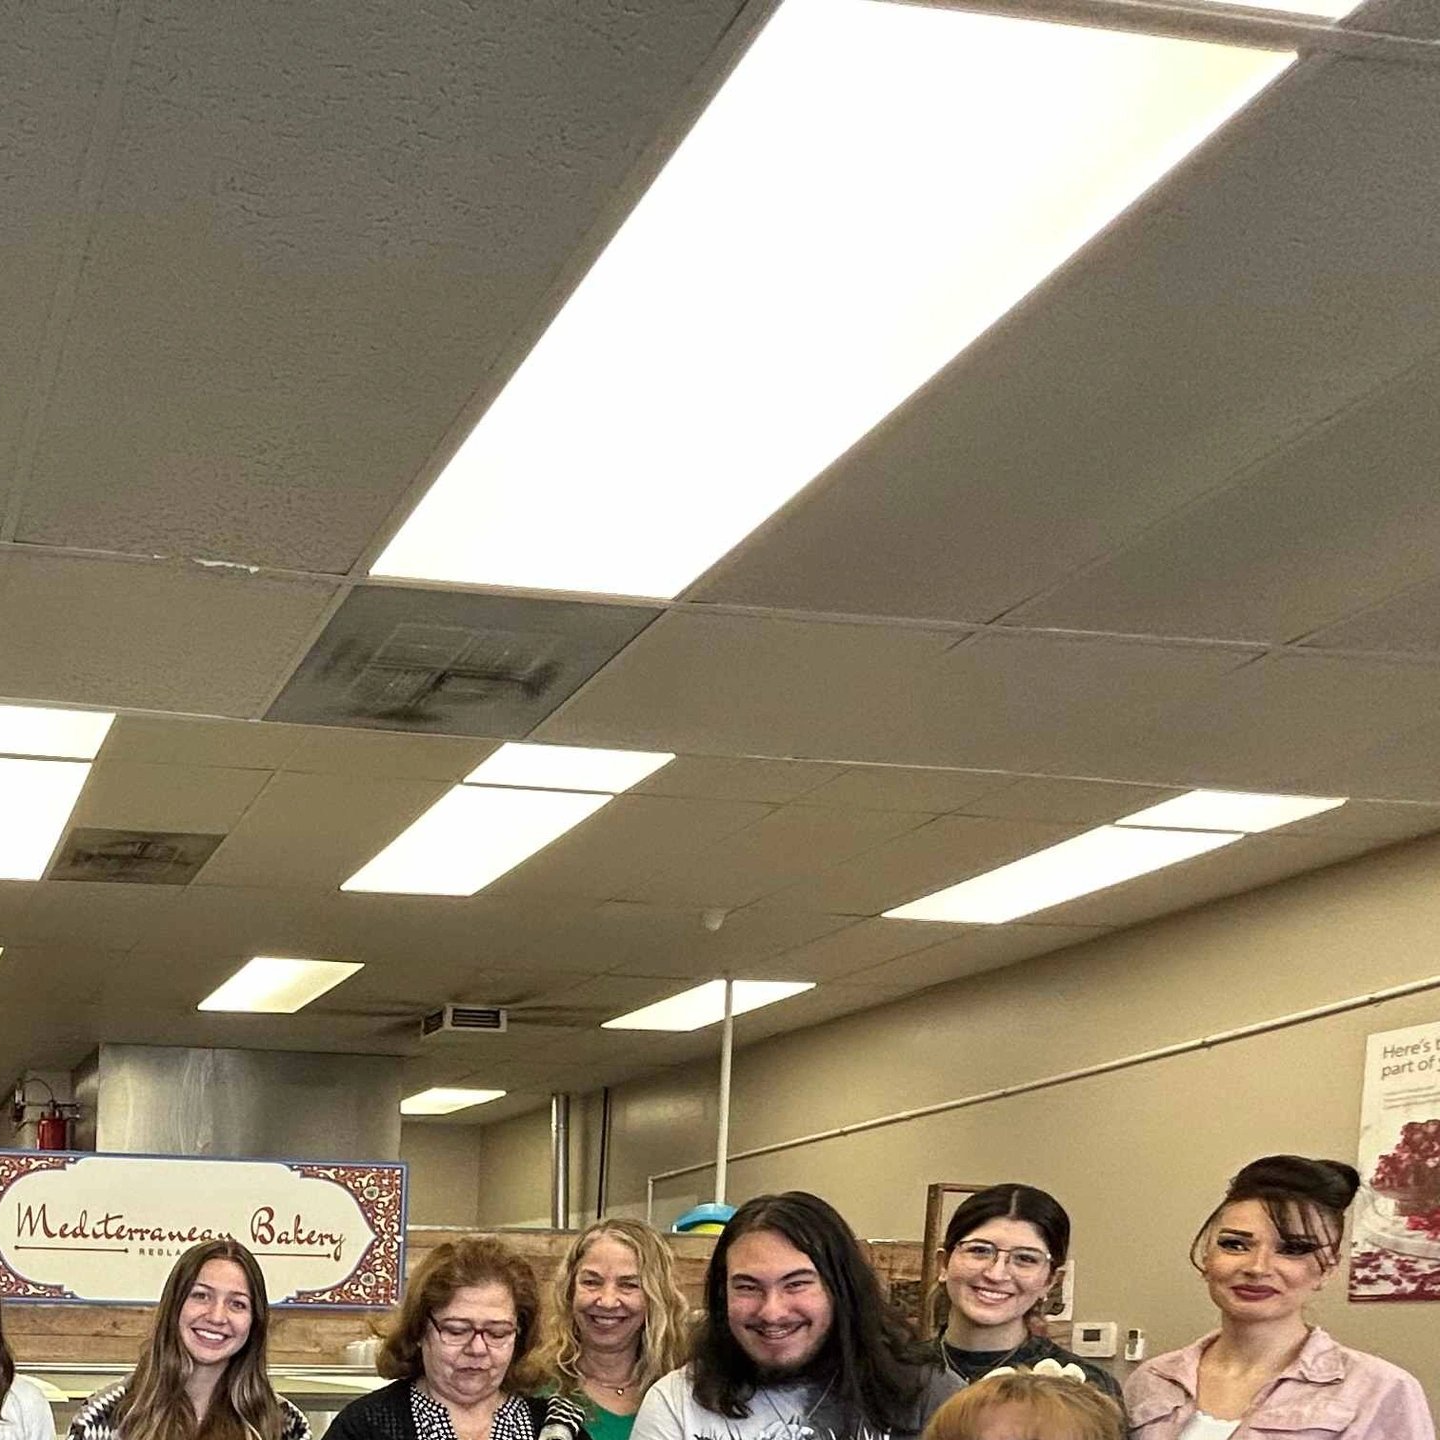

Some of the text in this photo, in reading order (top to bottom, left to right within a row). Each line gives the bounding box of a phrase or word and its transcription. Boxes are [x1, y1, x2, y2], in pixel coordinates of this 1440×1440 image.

[1383, 1038, 1431, 1060] Here's
[1381, 1061, 1414, 1081] part
[1418, 1055, 1436, 1072] of
[16, 1202, 347, 1262] Mediterranean Bakery
